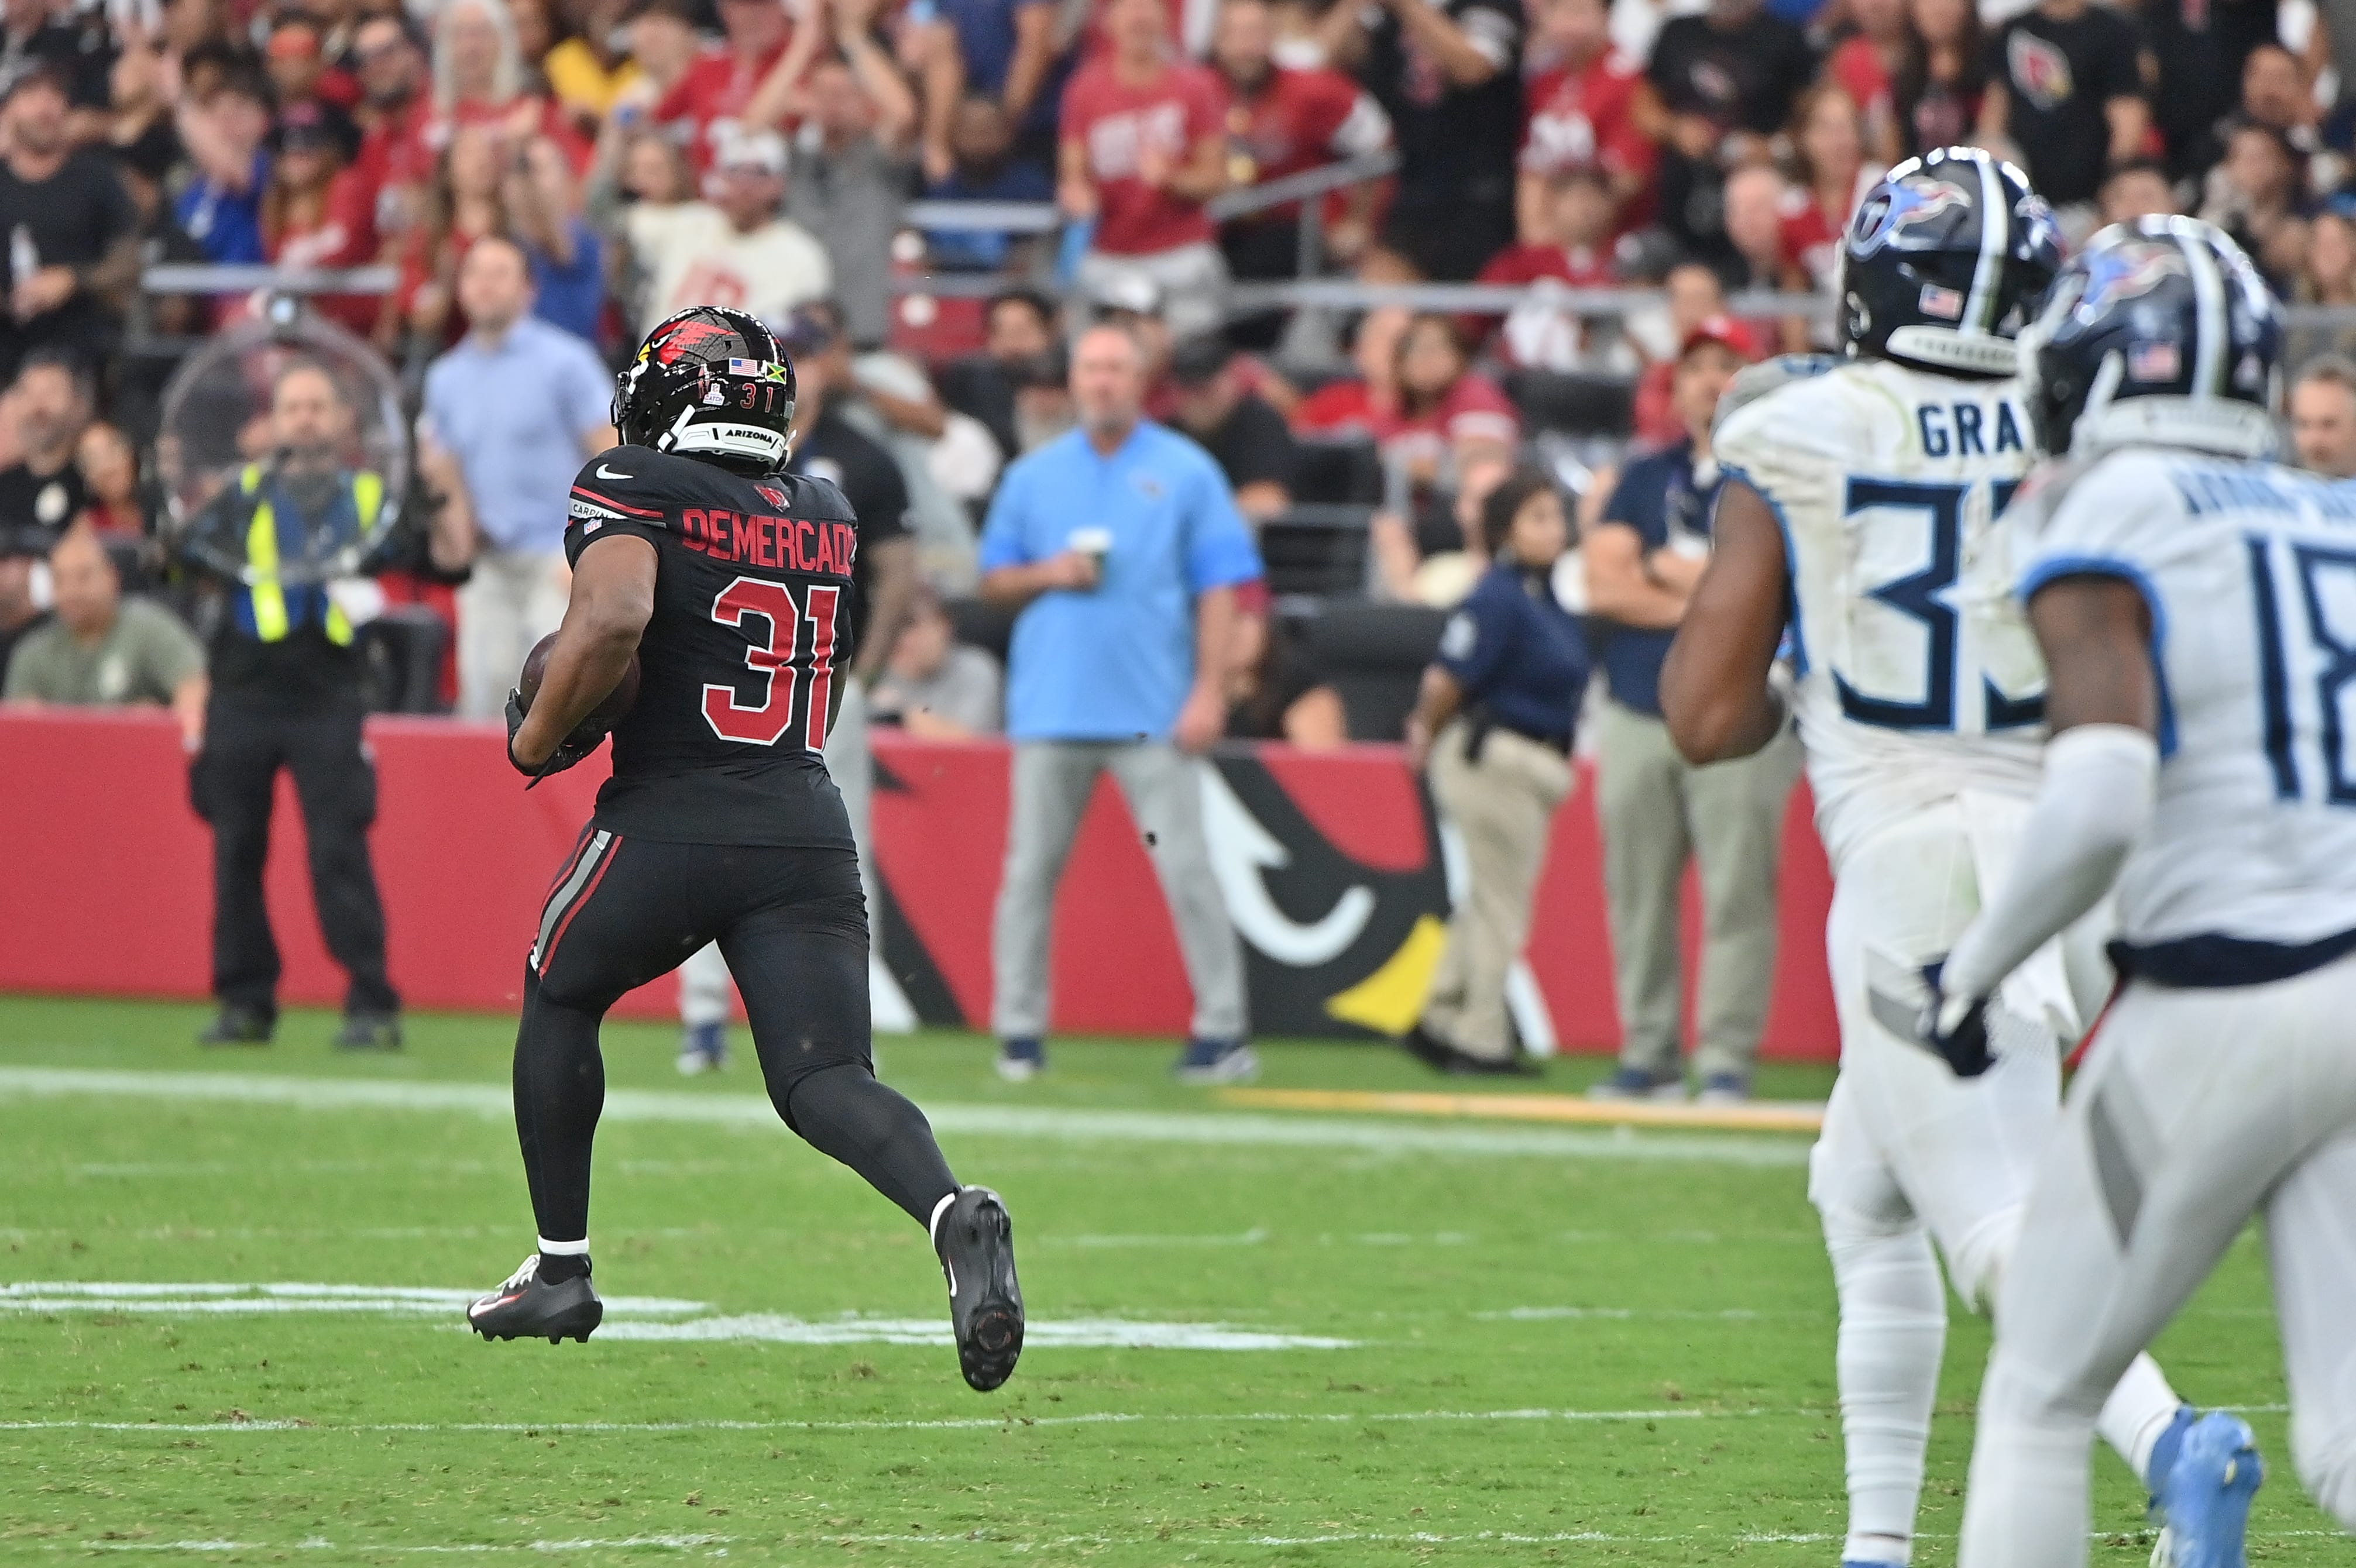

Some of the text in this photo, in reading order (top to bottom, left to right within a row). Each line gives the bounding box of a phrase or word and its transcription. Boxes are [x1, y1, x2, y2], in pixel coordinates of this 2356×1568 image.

[725, 429, 772, 443] ARIZONA
[1917, 401, 2024, 458] GRA
[701, 576, 840, 753] 31
